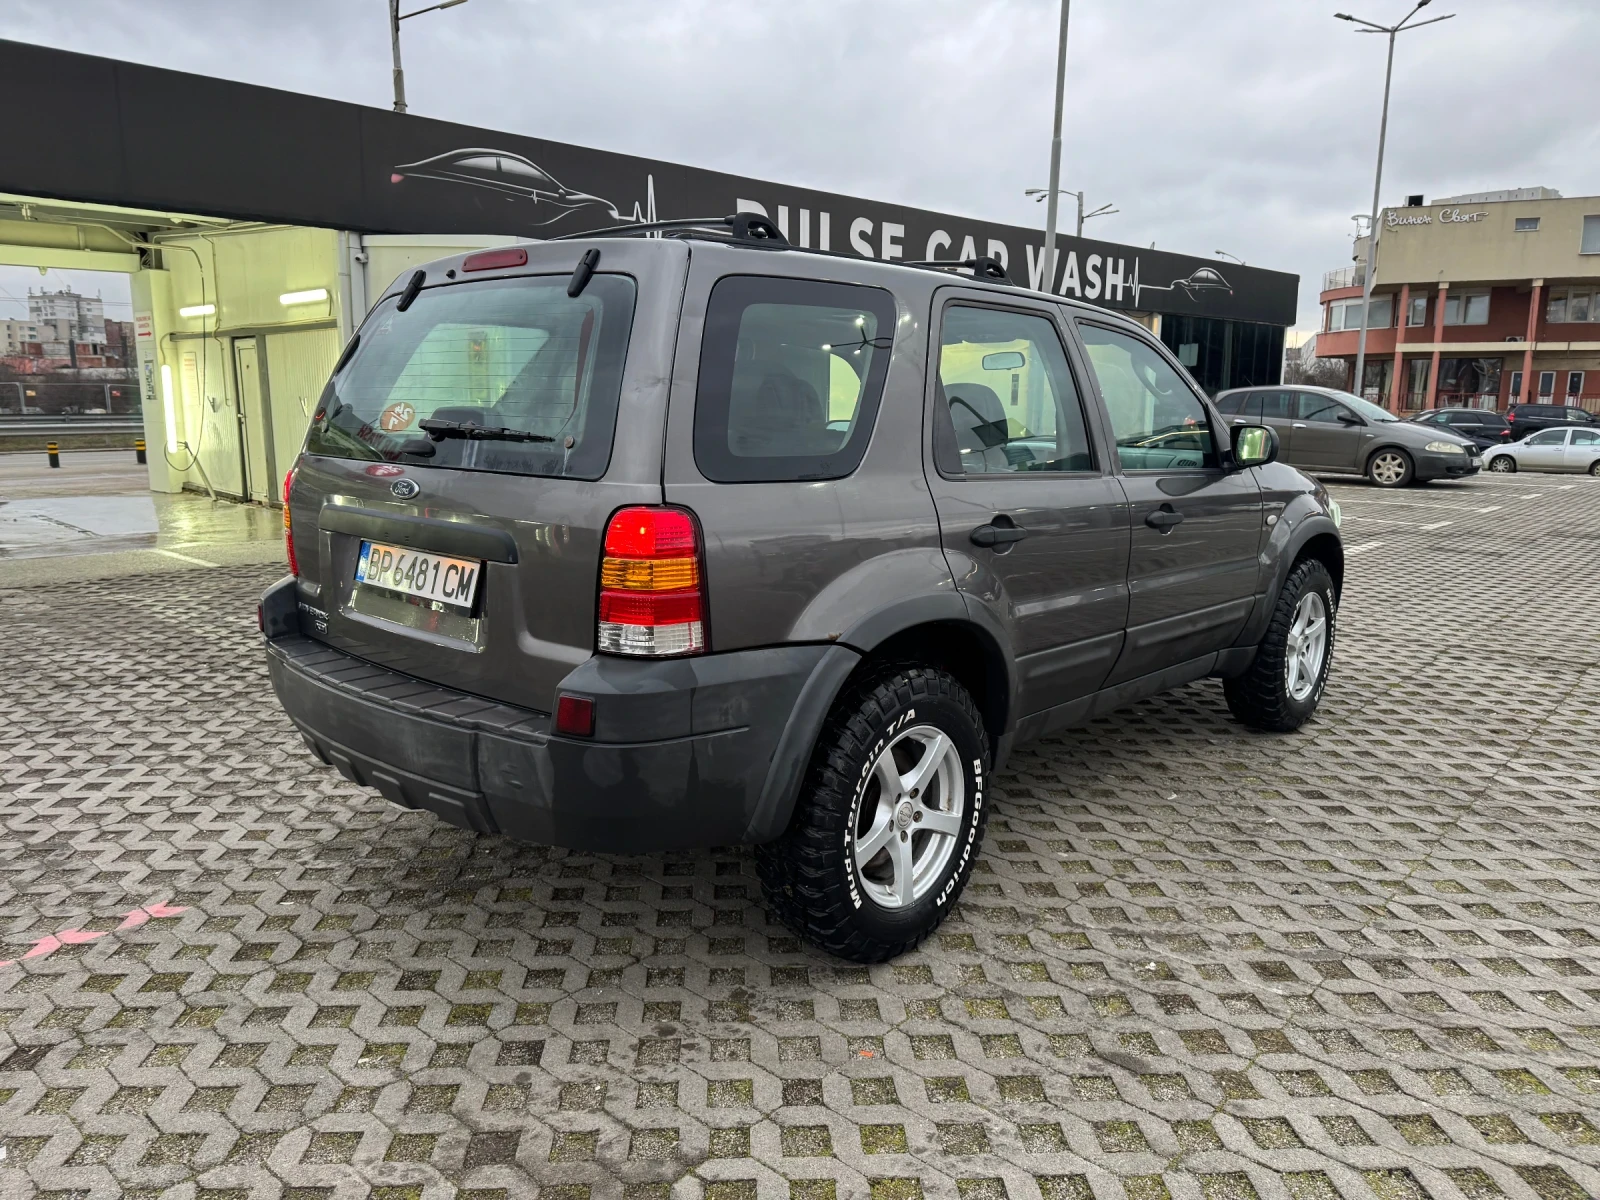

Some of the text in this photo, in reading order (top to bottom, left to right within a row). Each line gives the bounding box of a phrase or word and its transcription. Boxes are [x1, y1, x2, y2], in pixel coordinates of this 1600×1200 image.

[1026, 244, 1125, 302] WASH
[886, 708, 917, 736] T/A
[936, 758, 983, 907] BFGoodrich
